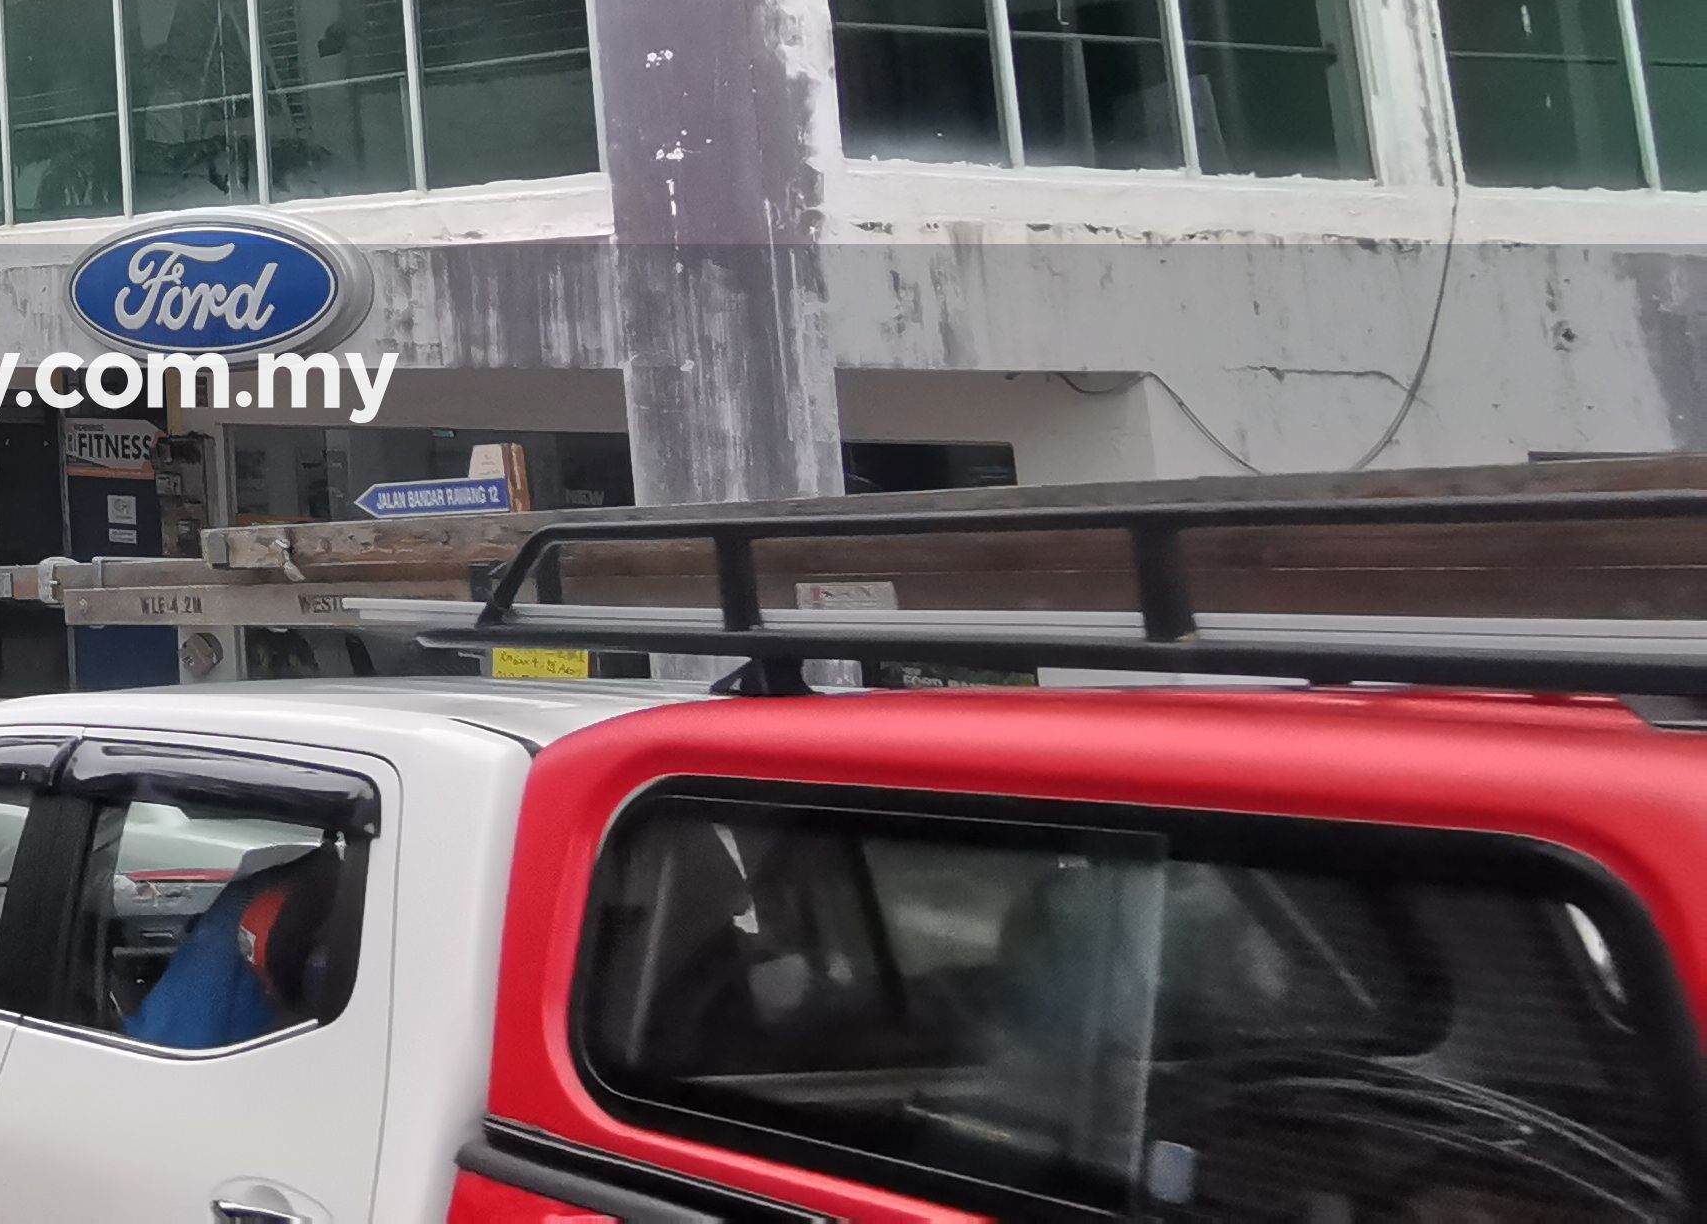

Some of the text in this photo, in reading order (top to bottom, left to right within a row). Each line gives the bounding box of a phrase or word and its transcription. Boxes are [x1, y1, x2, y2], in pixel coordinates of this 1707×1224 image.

[114, 241, 279, 332] Ford
[78, 433, 152, 460] FITNESS
[377, 484, 500, 510] JALAN BANDAR RAWANG 12
